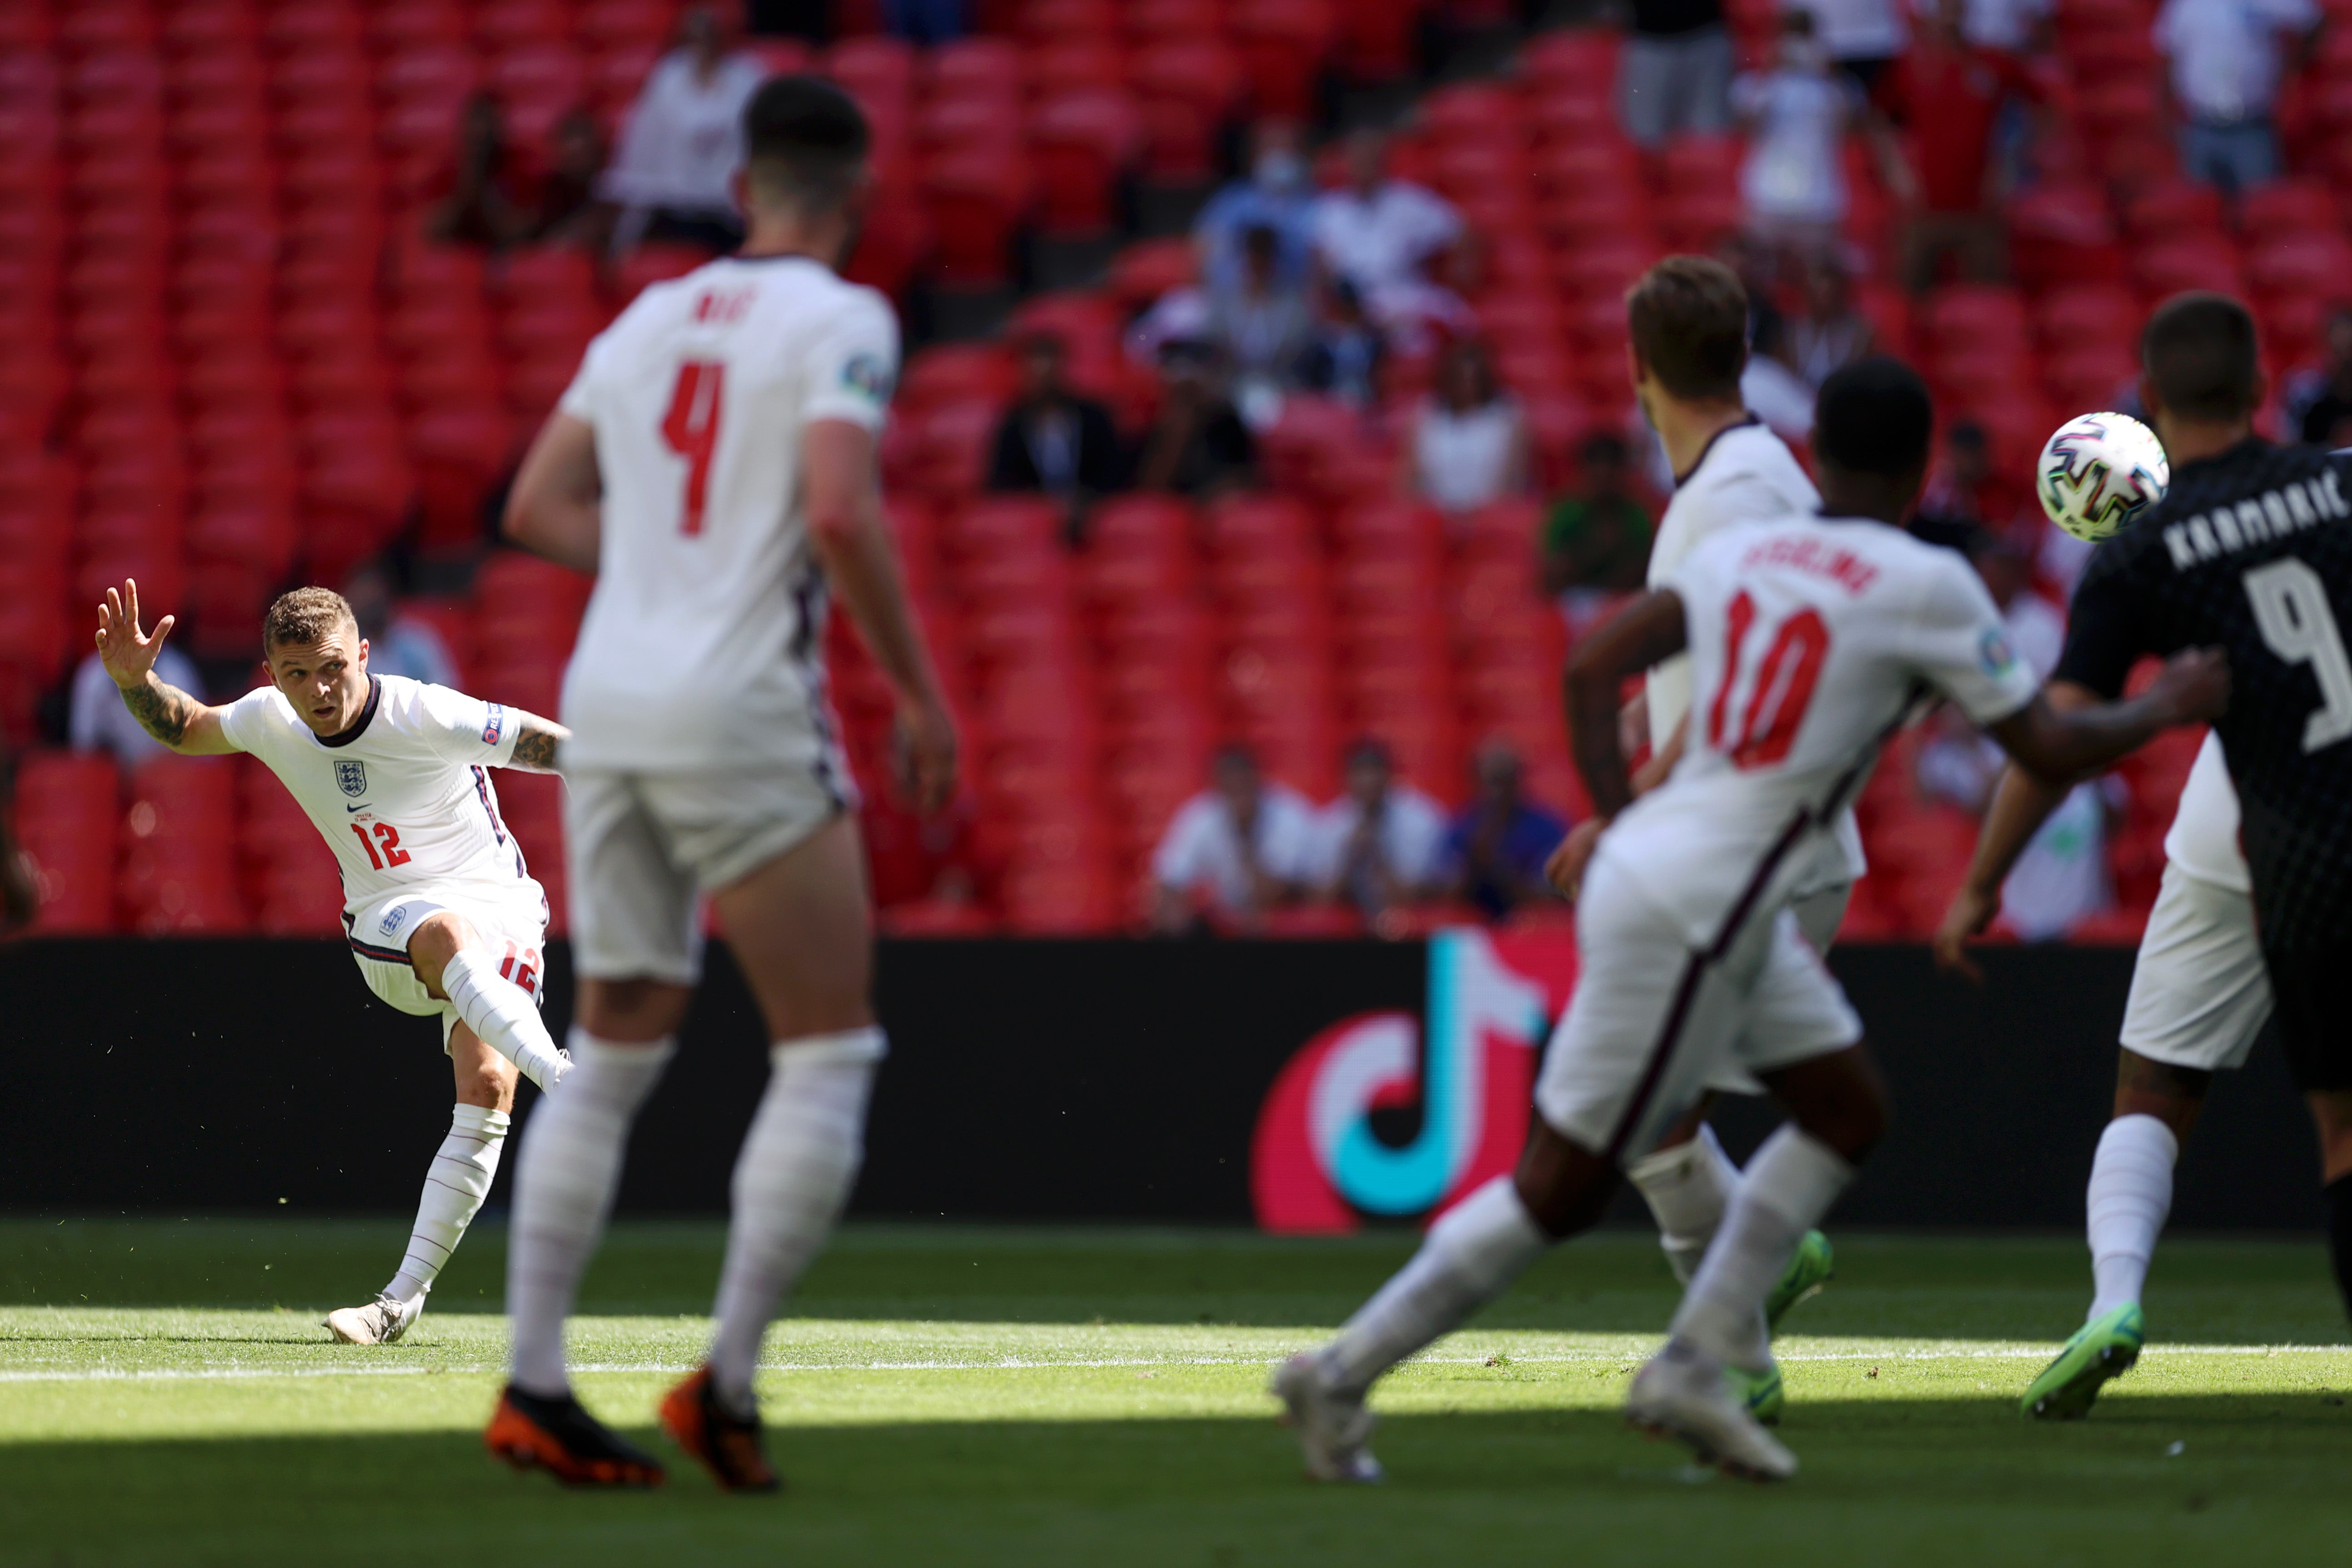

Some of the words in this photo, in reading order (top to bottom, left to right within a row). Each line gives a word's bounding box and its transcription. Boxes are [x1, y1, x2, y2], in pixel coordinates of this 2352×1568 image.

[662, 362, 728, 539] 4
[1707, 590, 1831, 770] 10
[2242, 556, 2352, 753] 9
[351, 823, 412, 871] 12
[500, 939, 540, 995] 12
